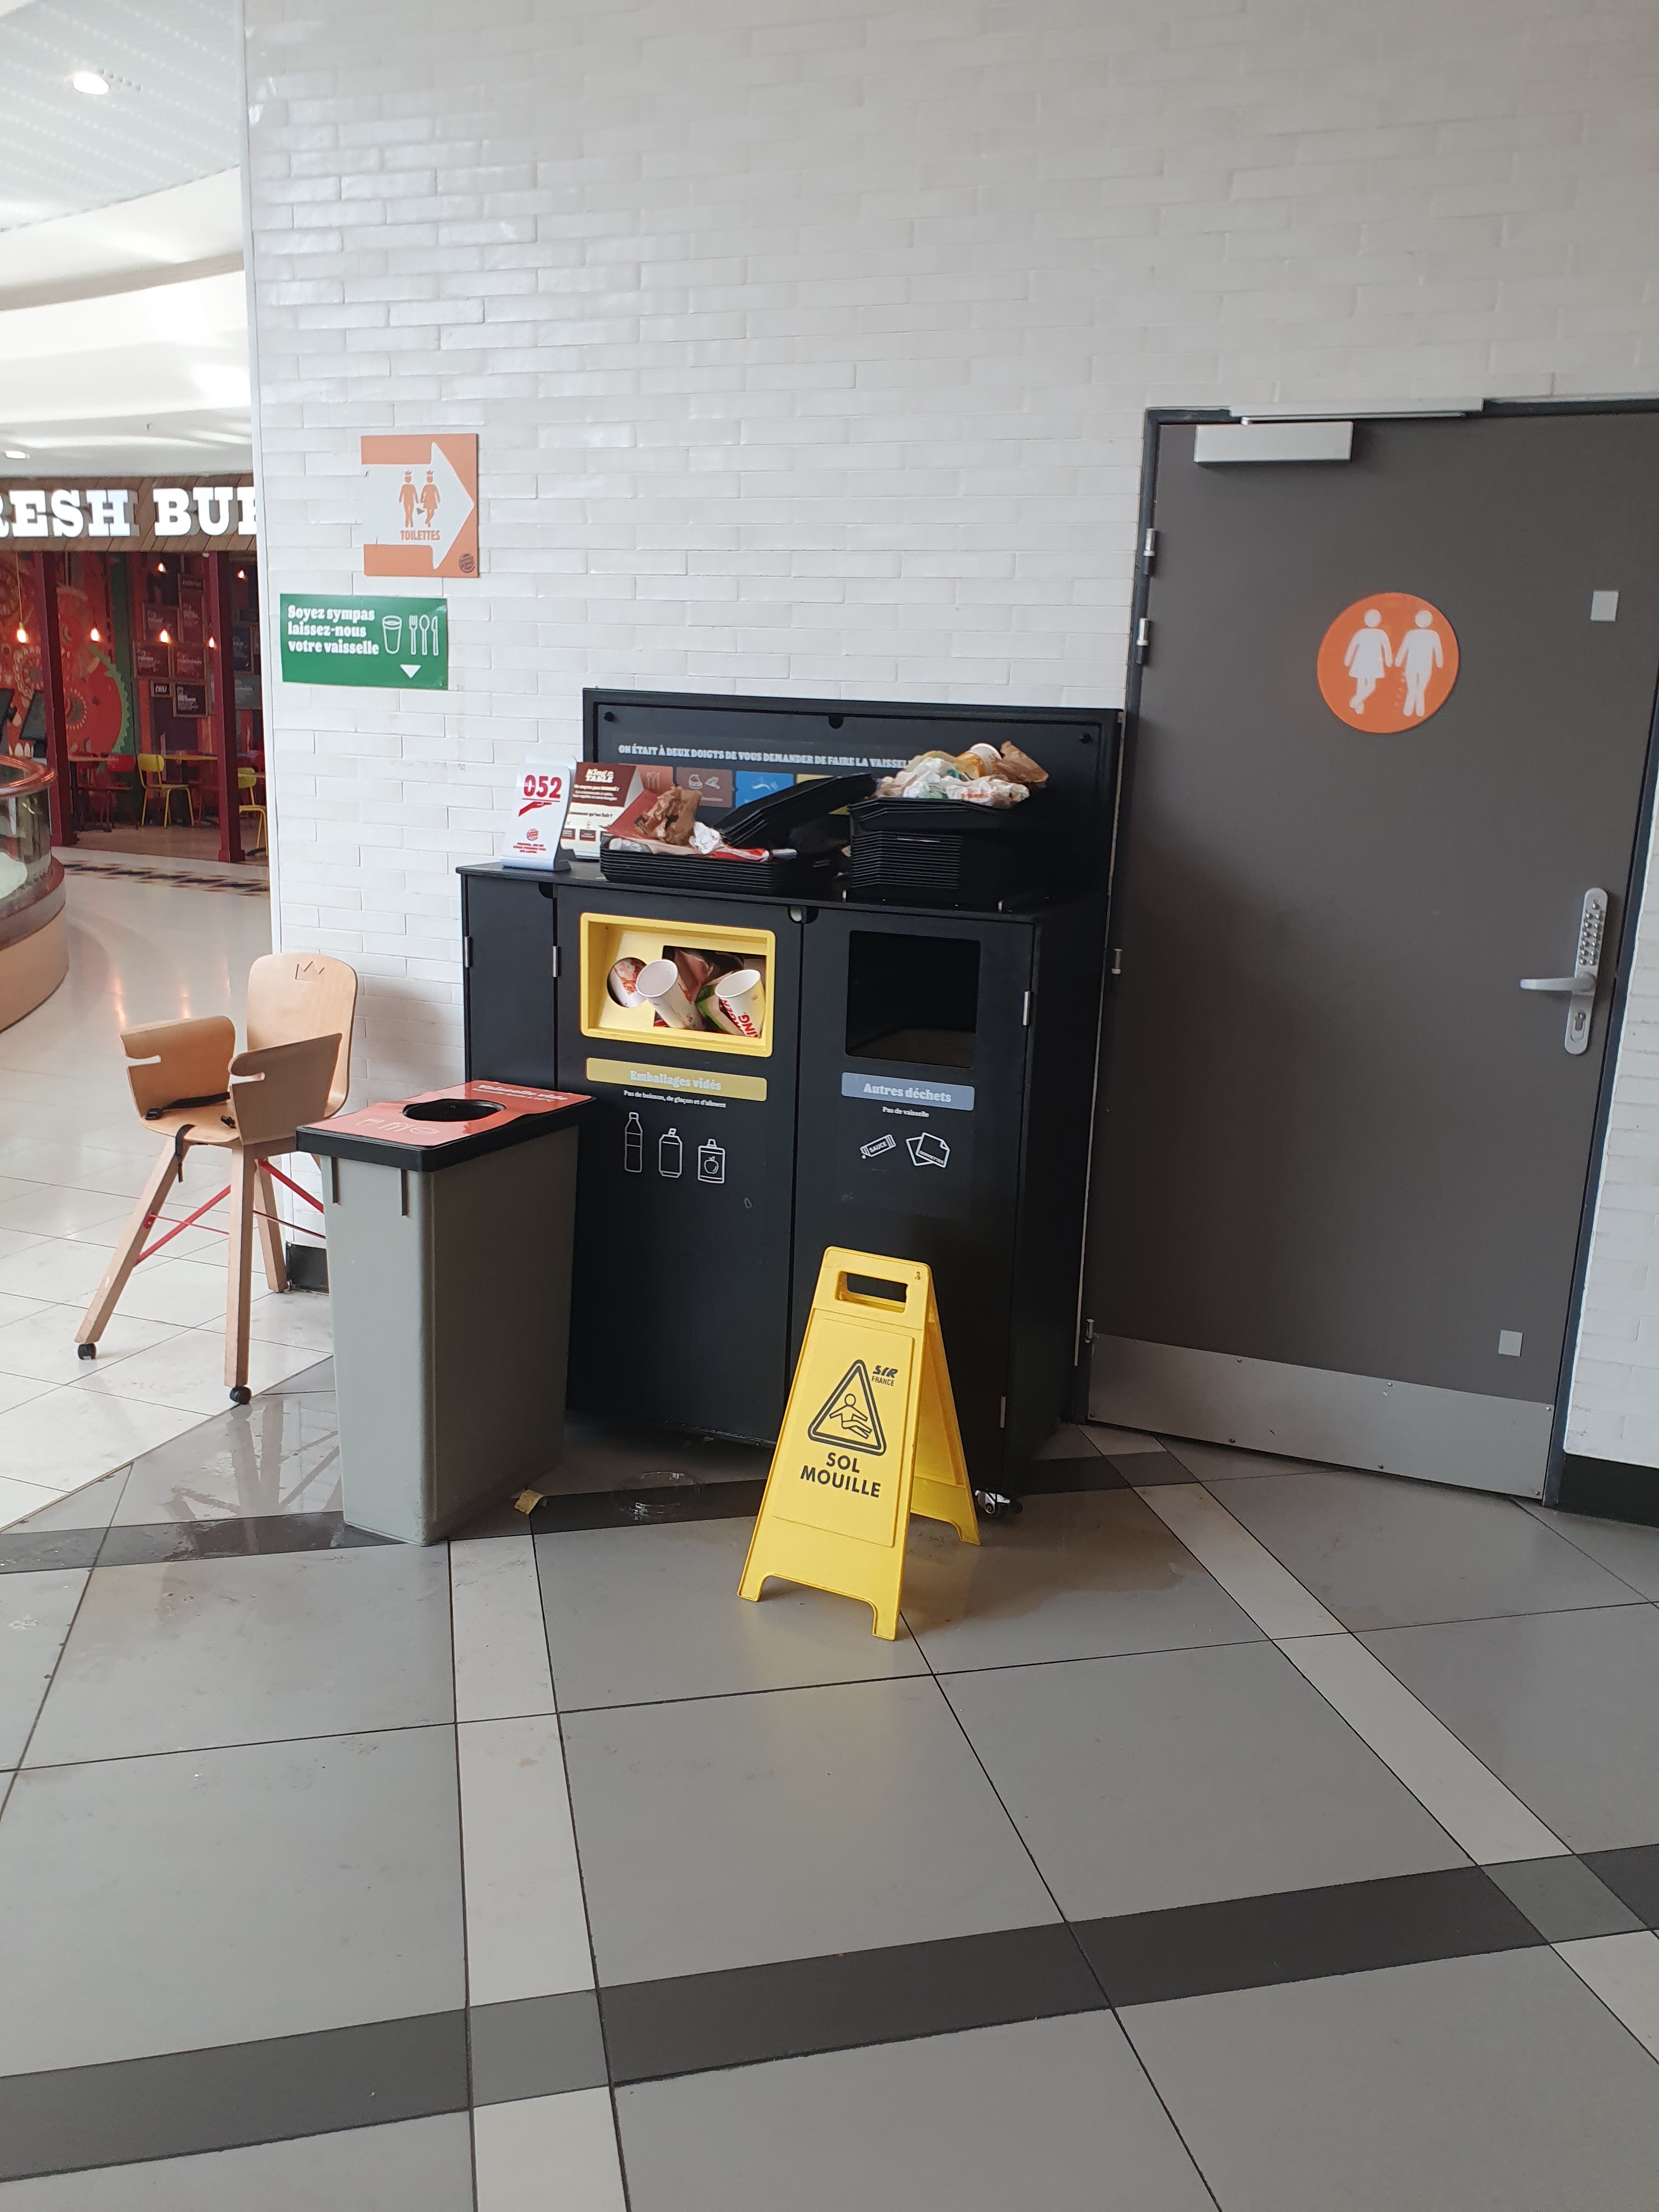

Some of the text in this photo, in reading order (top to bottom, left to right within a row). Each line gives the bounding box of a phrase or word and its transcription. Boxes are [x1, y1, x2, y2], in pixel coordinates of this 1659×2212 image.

[0, 489, 131, 537] ESH
[400, 530, 440, 540] TOILETTES
[287, 605, 375, 624] Soyez sympas
[287, 620, 366, 637] laissez-nous
[288, 639, 380, 655] votre vaisselle
[618, 744, 630, 754] ON
[631, 743, 658, 755] ÉTAIT
[658, 744, 666, 756] À
[666, 747, 691, 757] DEUX
[691, 749, 724, 759] DOIGTS
[725, 751, 737, 760] DE
[738, 752, 762, 761] VOUS
[763, 753, 814, 764] DEMANDER
[814, 755, 827, 765] DE
[828, 756, 855, 766] FAIRE
[855, 757, 869, 767] LA
[524, 775, 561, 799] 052
[630, 1070, 721, 1091] Emballages vidés
[642, 1092, 666, 1102] boisson,
[674, 1096, 693, 1104] glaçon
[701, 1099, 726, 1108] d'aliment
[863, 1083, 952, 1103] Autres déchets
[903, 1109, 930, 1118] vaisselle
[868, 1141, 888, 1153] SAUCE
[872, 1375, 894, 1386] FRANCE
[873, 1365, 898, 1378] SIR
[826, 1452, 860, 1474] SOL
[800, 1465, 881, 1498] MOUILLE
